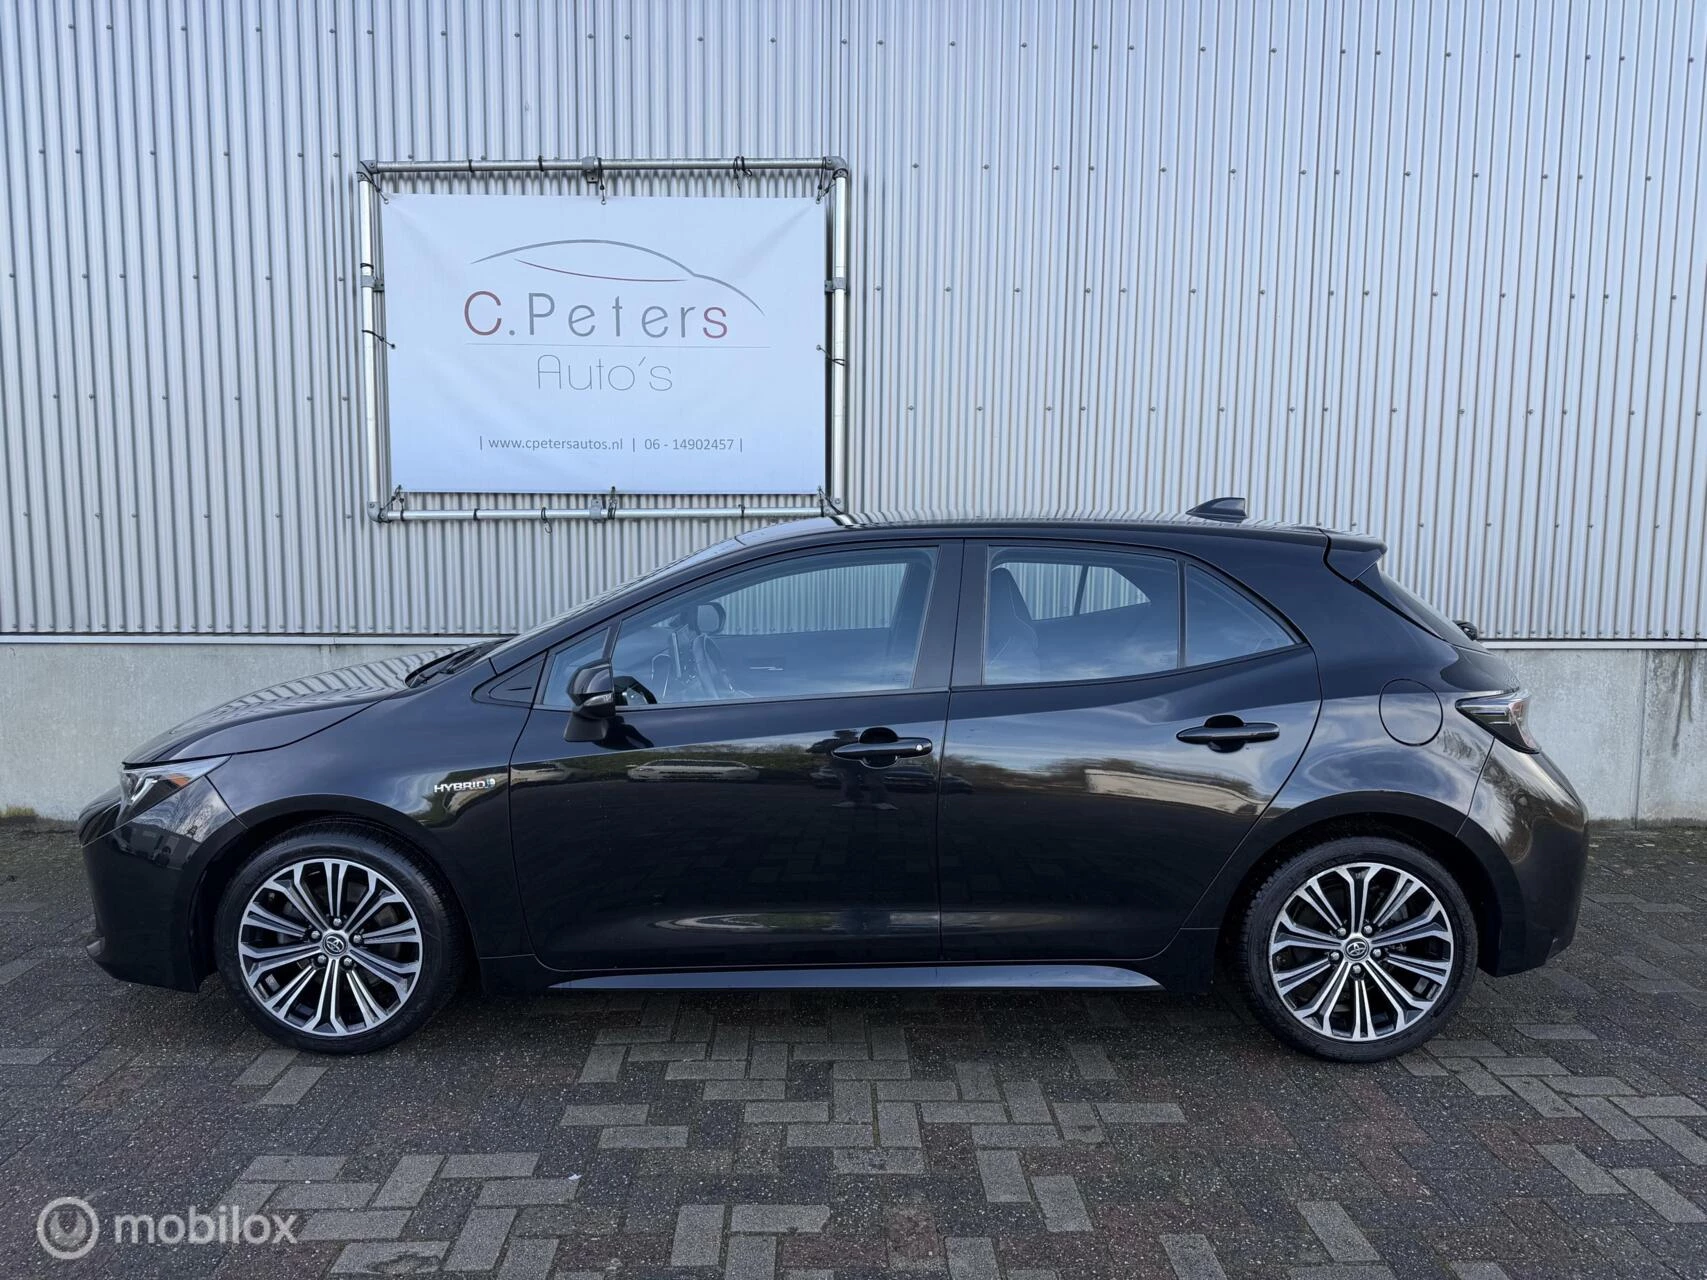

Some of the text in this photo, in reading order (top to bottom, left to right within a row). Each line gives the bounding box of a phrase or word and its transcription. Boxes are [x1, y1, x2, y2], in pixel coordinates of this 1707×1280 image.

[537, 354, 673, 391] Auto's
[488, 436, 623, 452] www.cpetersautos.nl
[672, 438, 734, 450] 14902457
[434, 780, 486, 793] HYBRID
